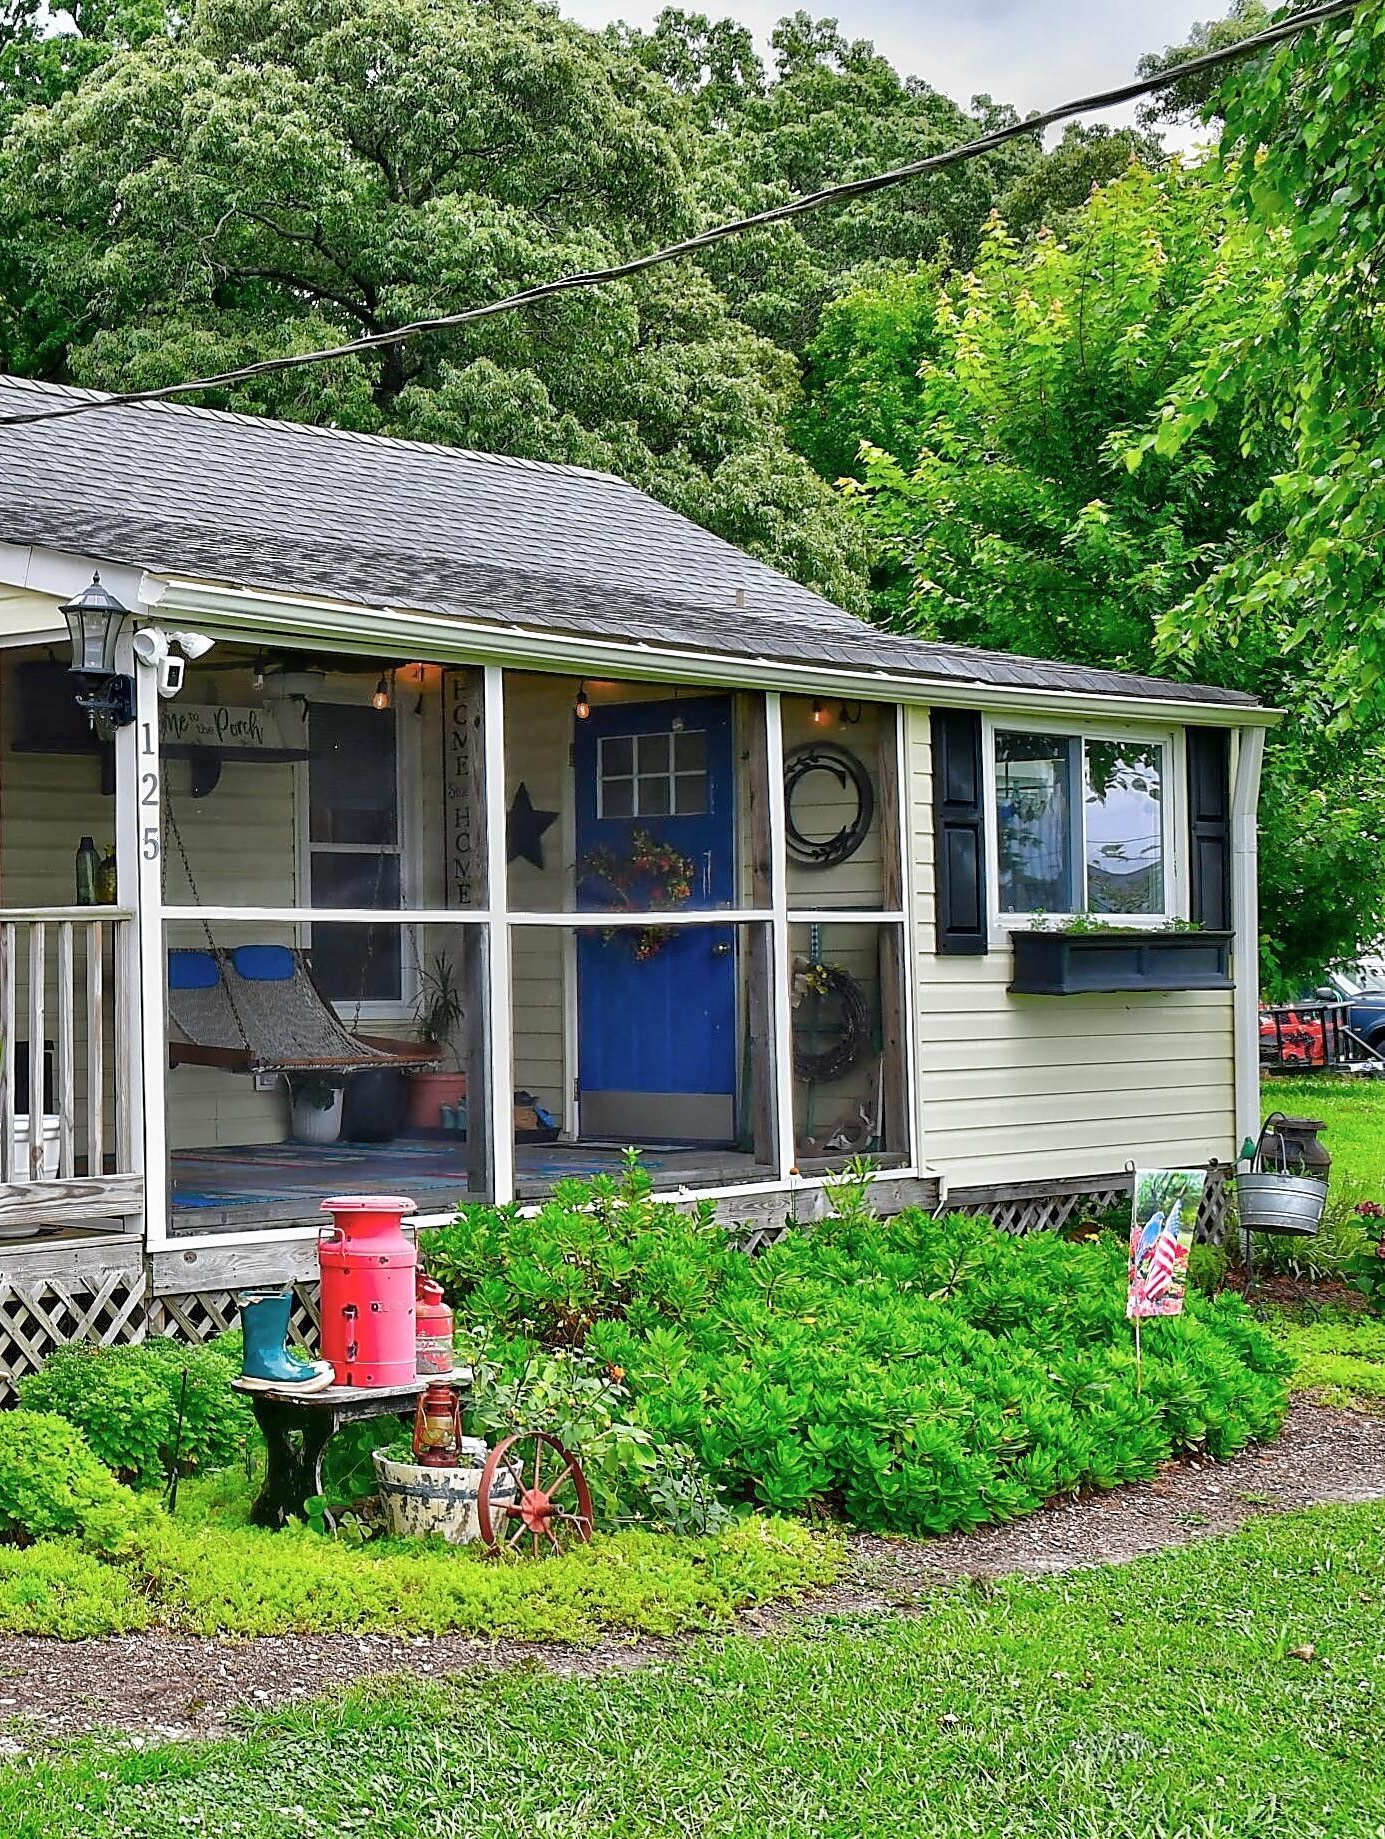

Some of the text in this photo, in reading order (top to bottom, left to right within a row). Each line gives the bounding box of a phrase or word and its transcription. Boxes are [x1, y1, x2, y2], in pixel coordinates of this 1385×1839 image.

[214, 707, 264, 745] Porch
[142, 722, 160, 860] 125
[455, 808, 471, 904] HOME
